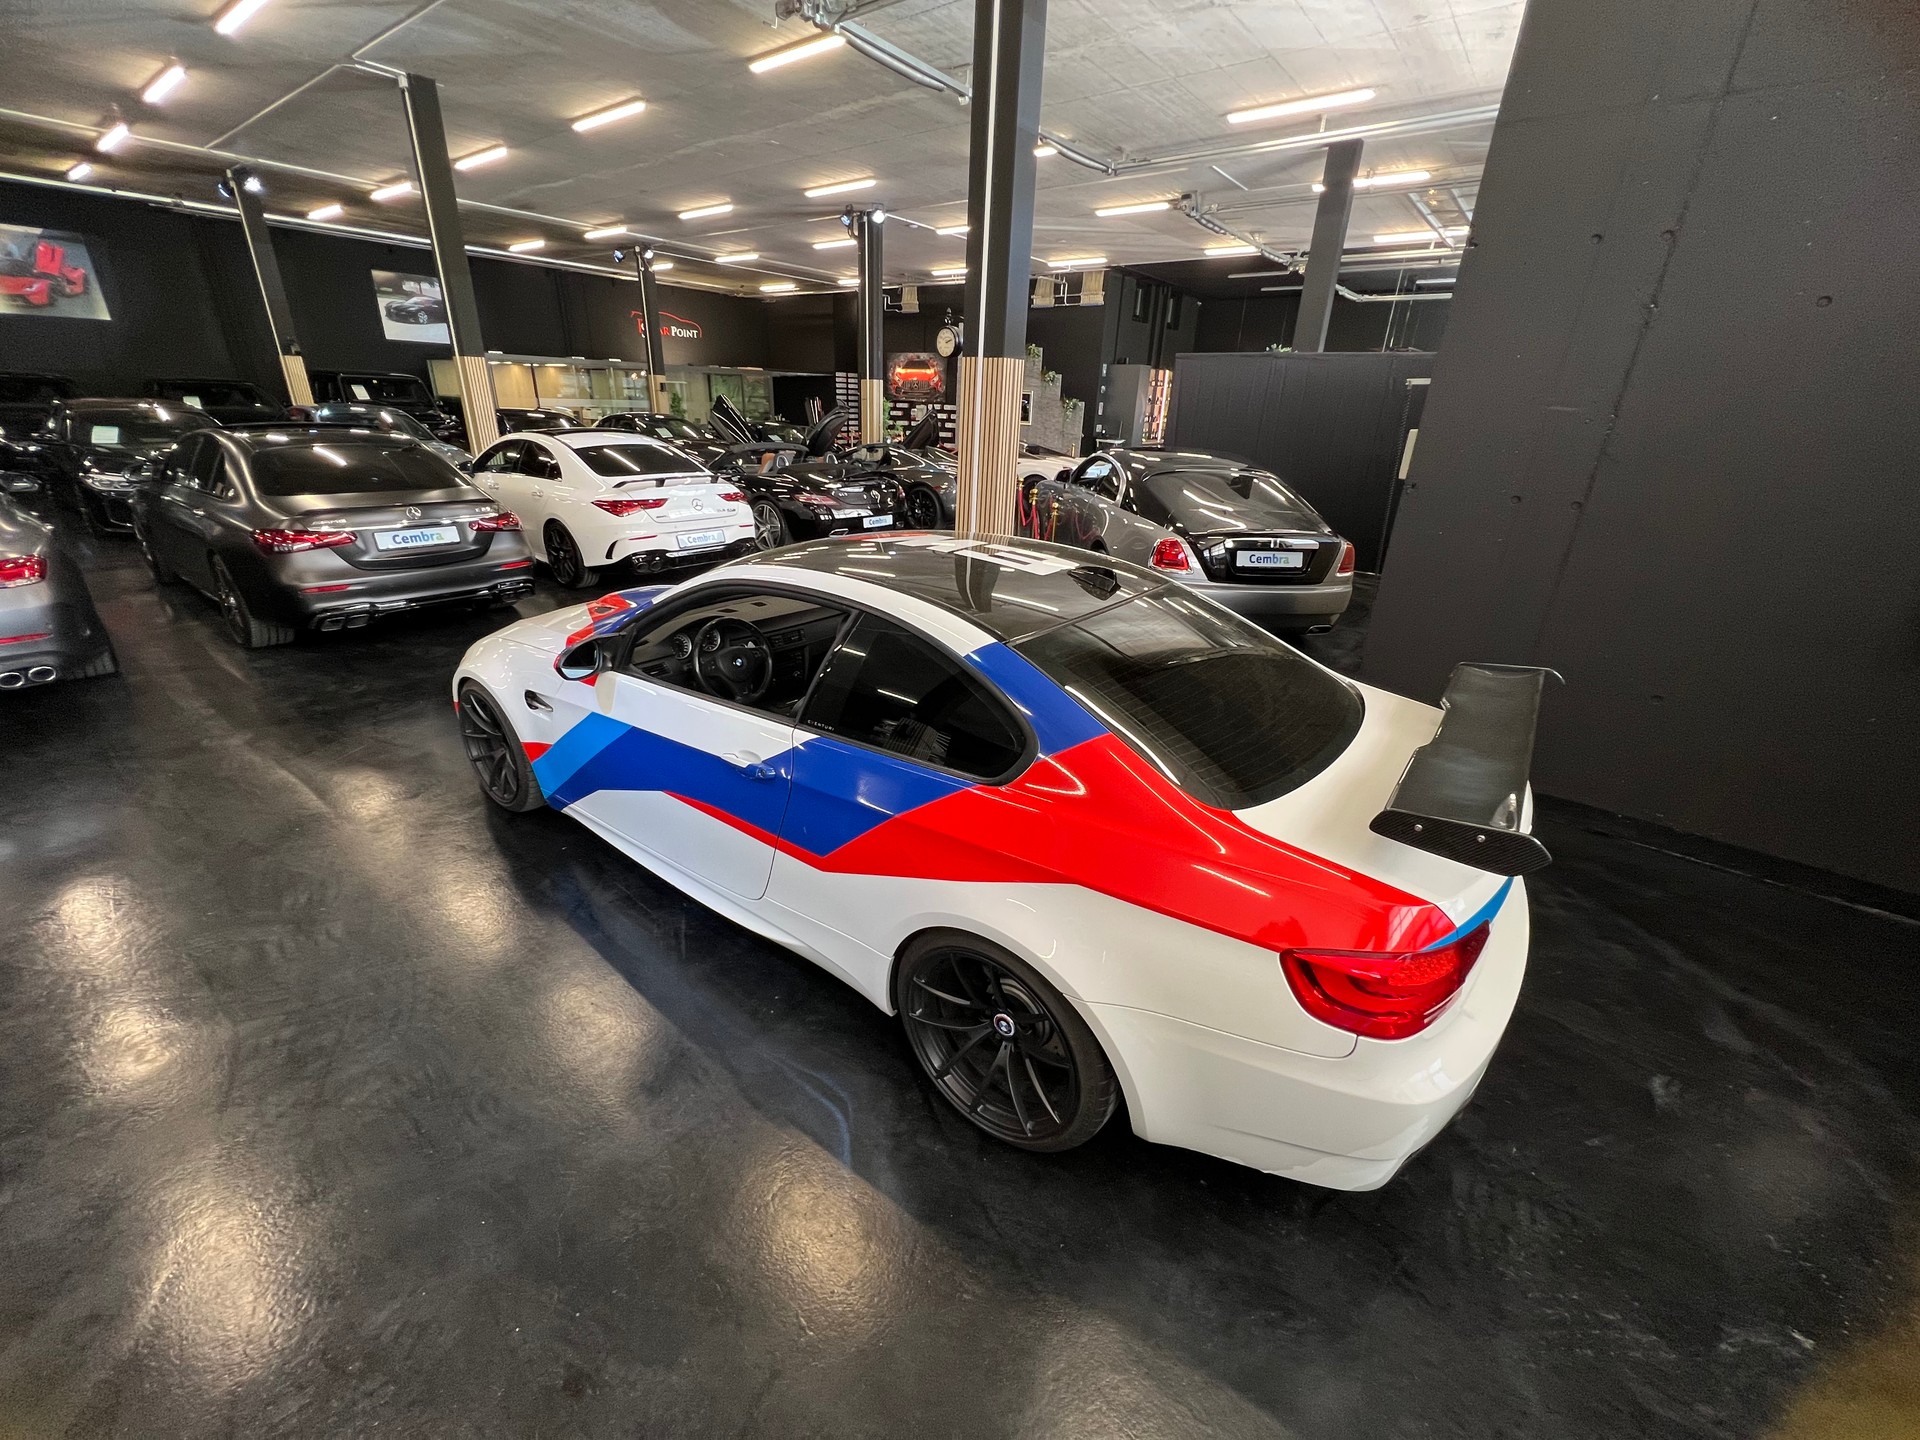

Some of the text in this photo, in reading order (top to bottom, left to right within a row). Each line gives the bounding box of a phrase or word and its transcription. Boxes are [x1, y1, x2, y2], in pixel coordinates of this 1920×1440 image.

[670, 325, 698, 339] POINT
[392, 530, 444, 545] Cembra
[687, 533, 716, 544] Cembra
[1249, 553, 1290, 565] Cembra
